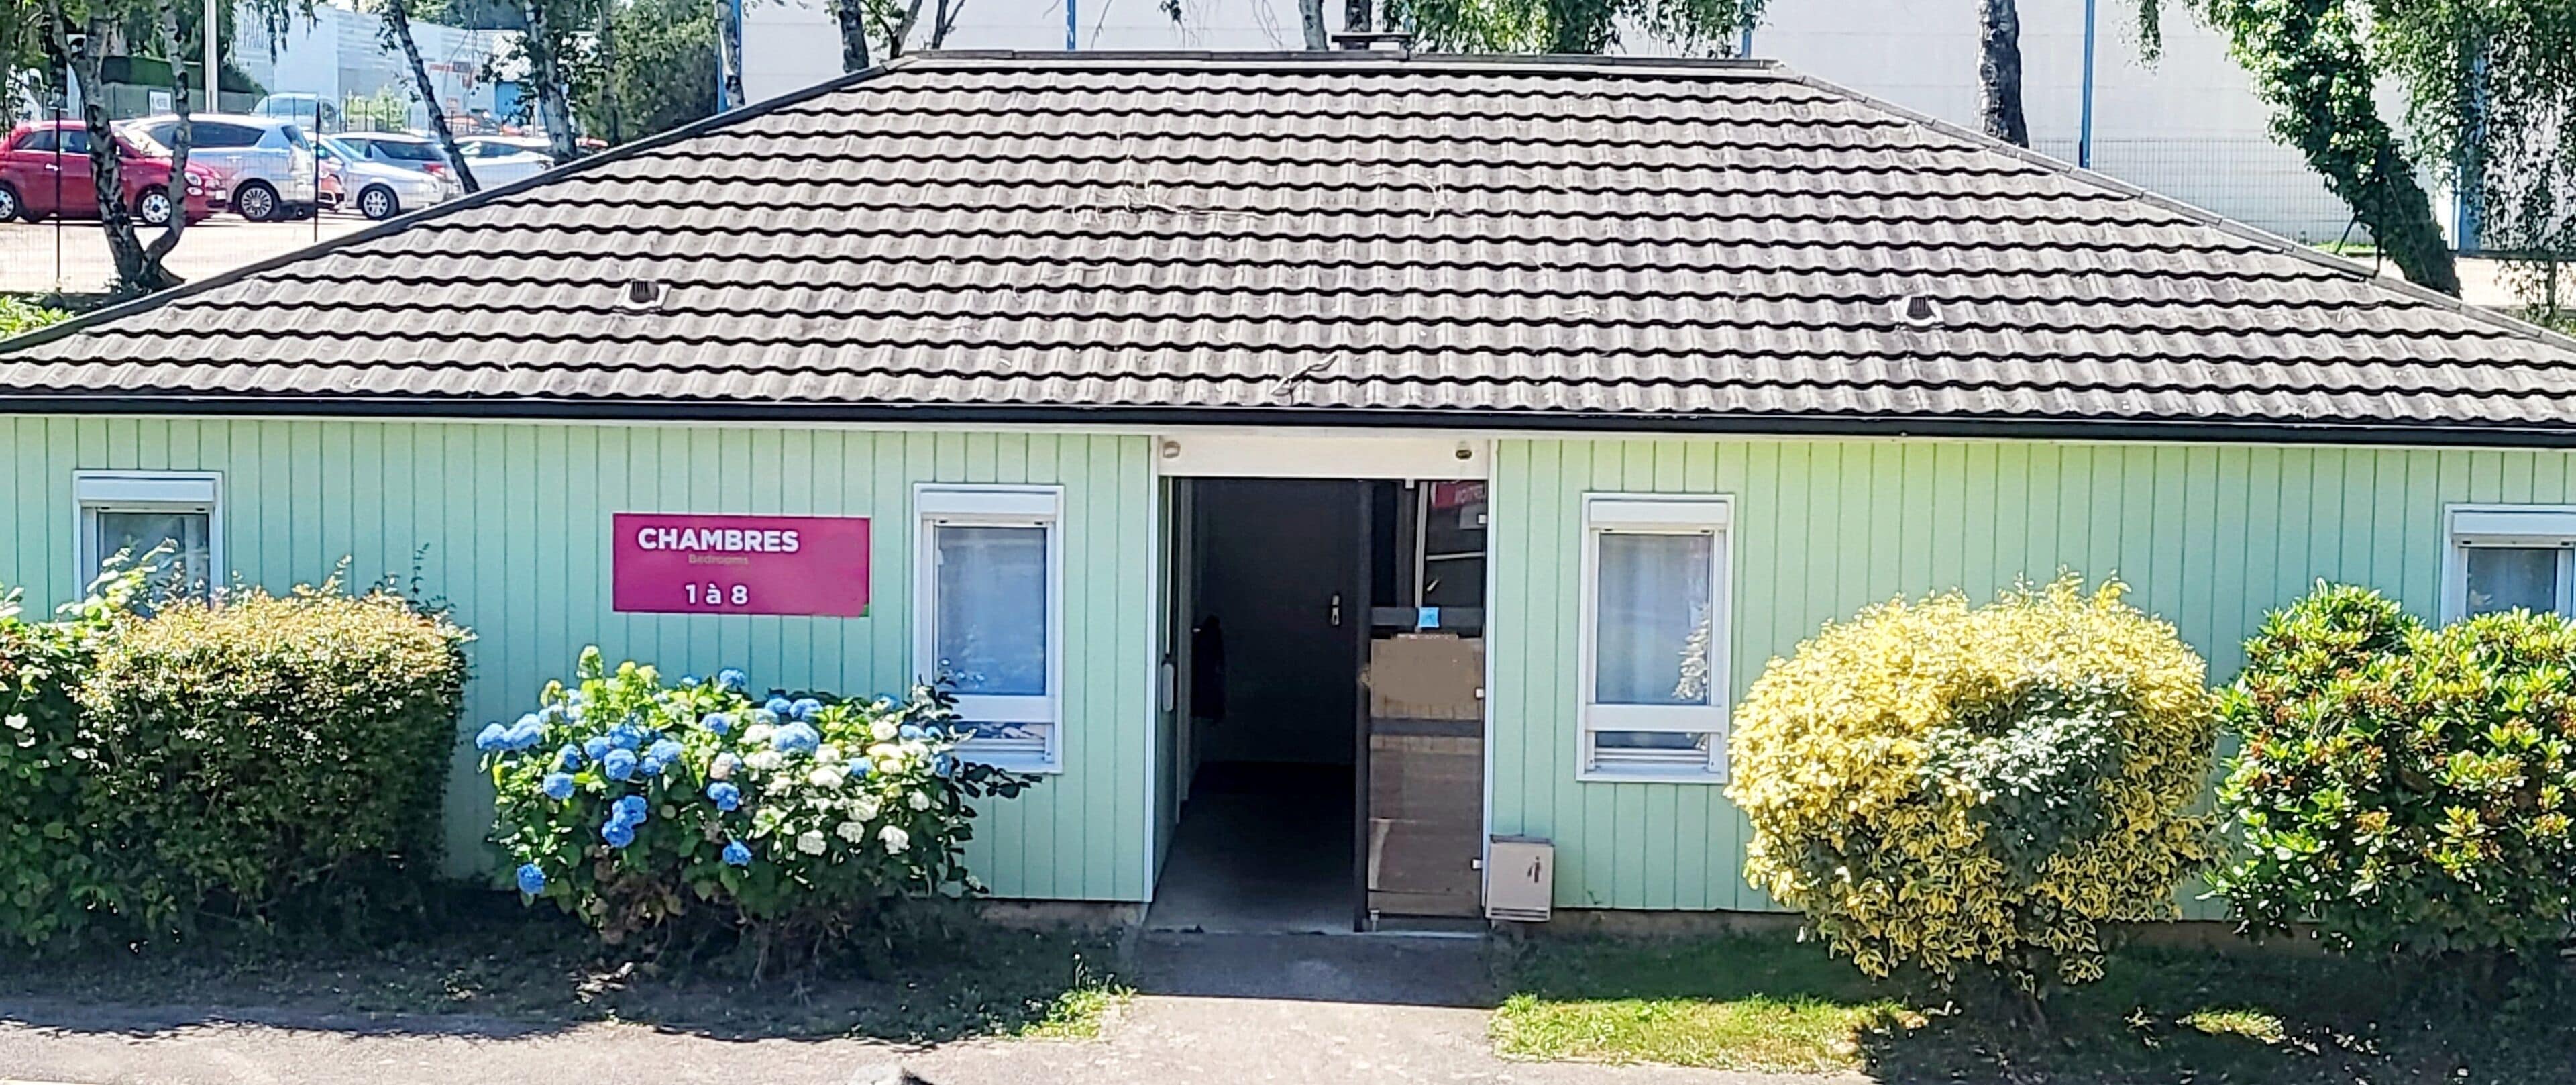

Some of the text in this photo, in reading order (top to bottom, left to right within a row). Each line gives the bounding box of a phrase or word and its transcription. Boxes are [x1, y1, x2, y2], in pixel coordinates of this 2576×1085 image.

[638, 527, 799, 552] CHAMBRES
[688, 554, 749, 564] Bedrooms
[685, 583, 748, 604] 1 à 8
